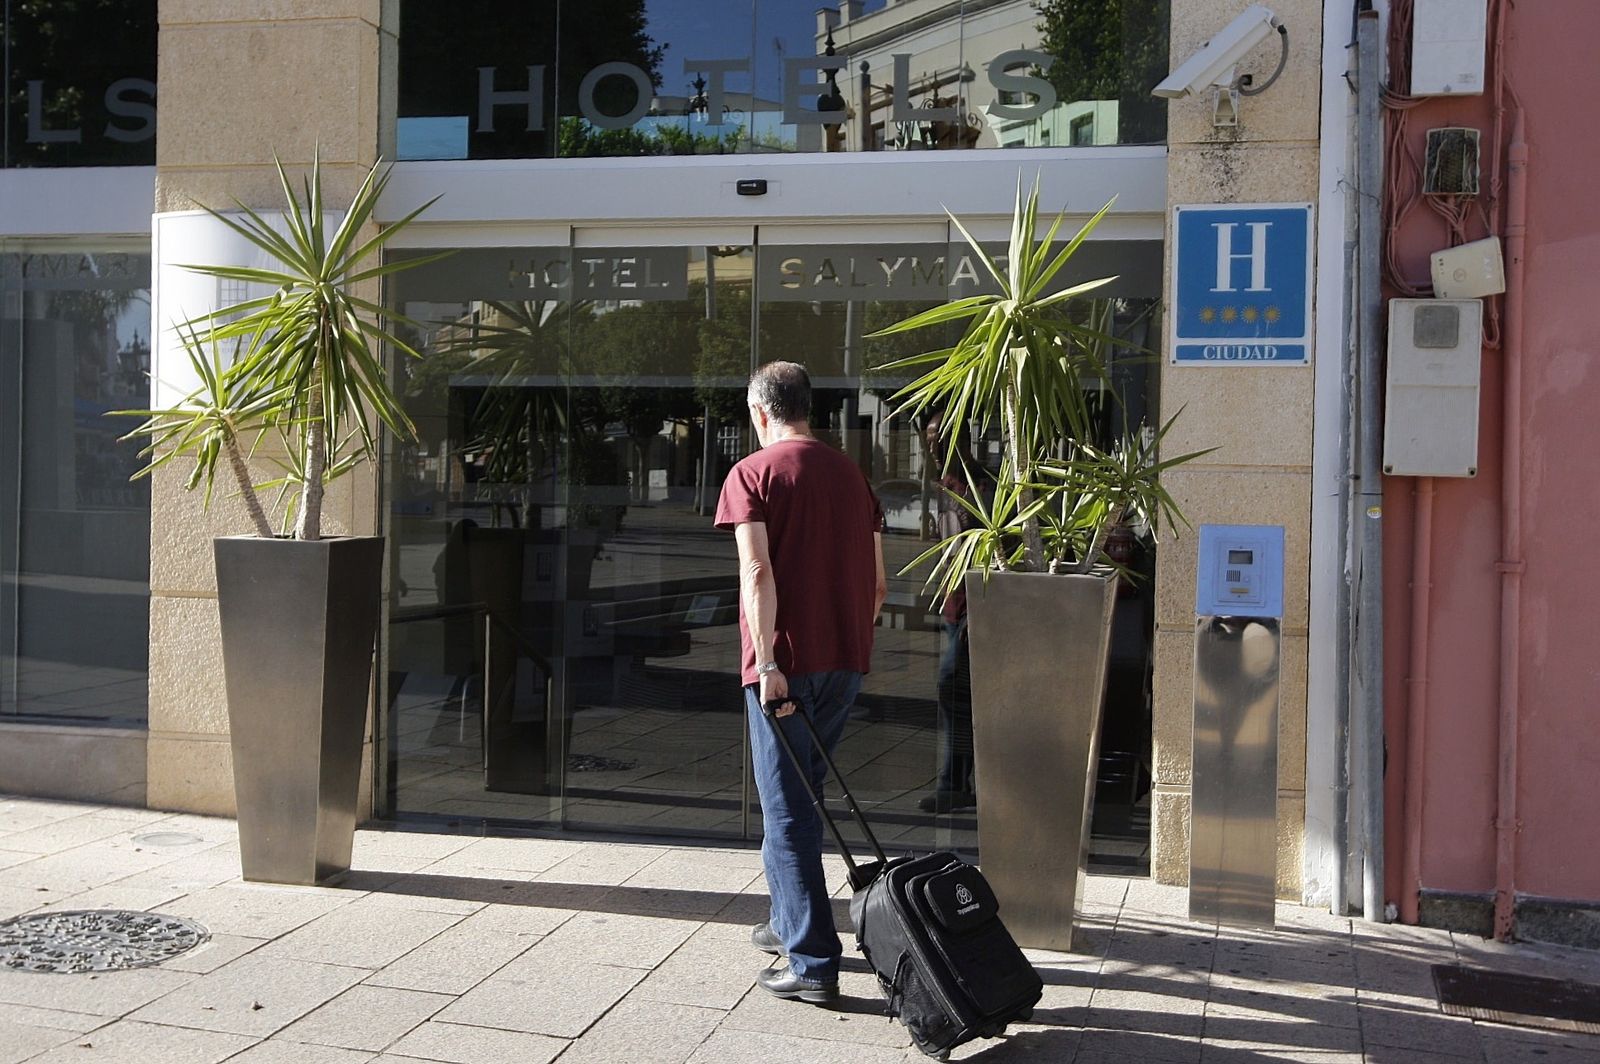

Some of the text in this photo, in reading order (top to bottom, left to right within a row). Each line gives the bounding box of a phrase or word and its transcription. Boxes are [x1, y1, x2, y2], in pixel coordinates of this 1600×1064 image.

[25, 77, 156, 143] LS
[475, 48, 1057, 133] HOTELS
[508, 256, 670, 289] HOTEL
[1209, 221, 1273, 292] H
[1203, 345, 1277, 361] CIUDAD
